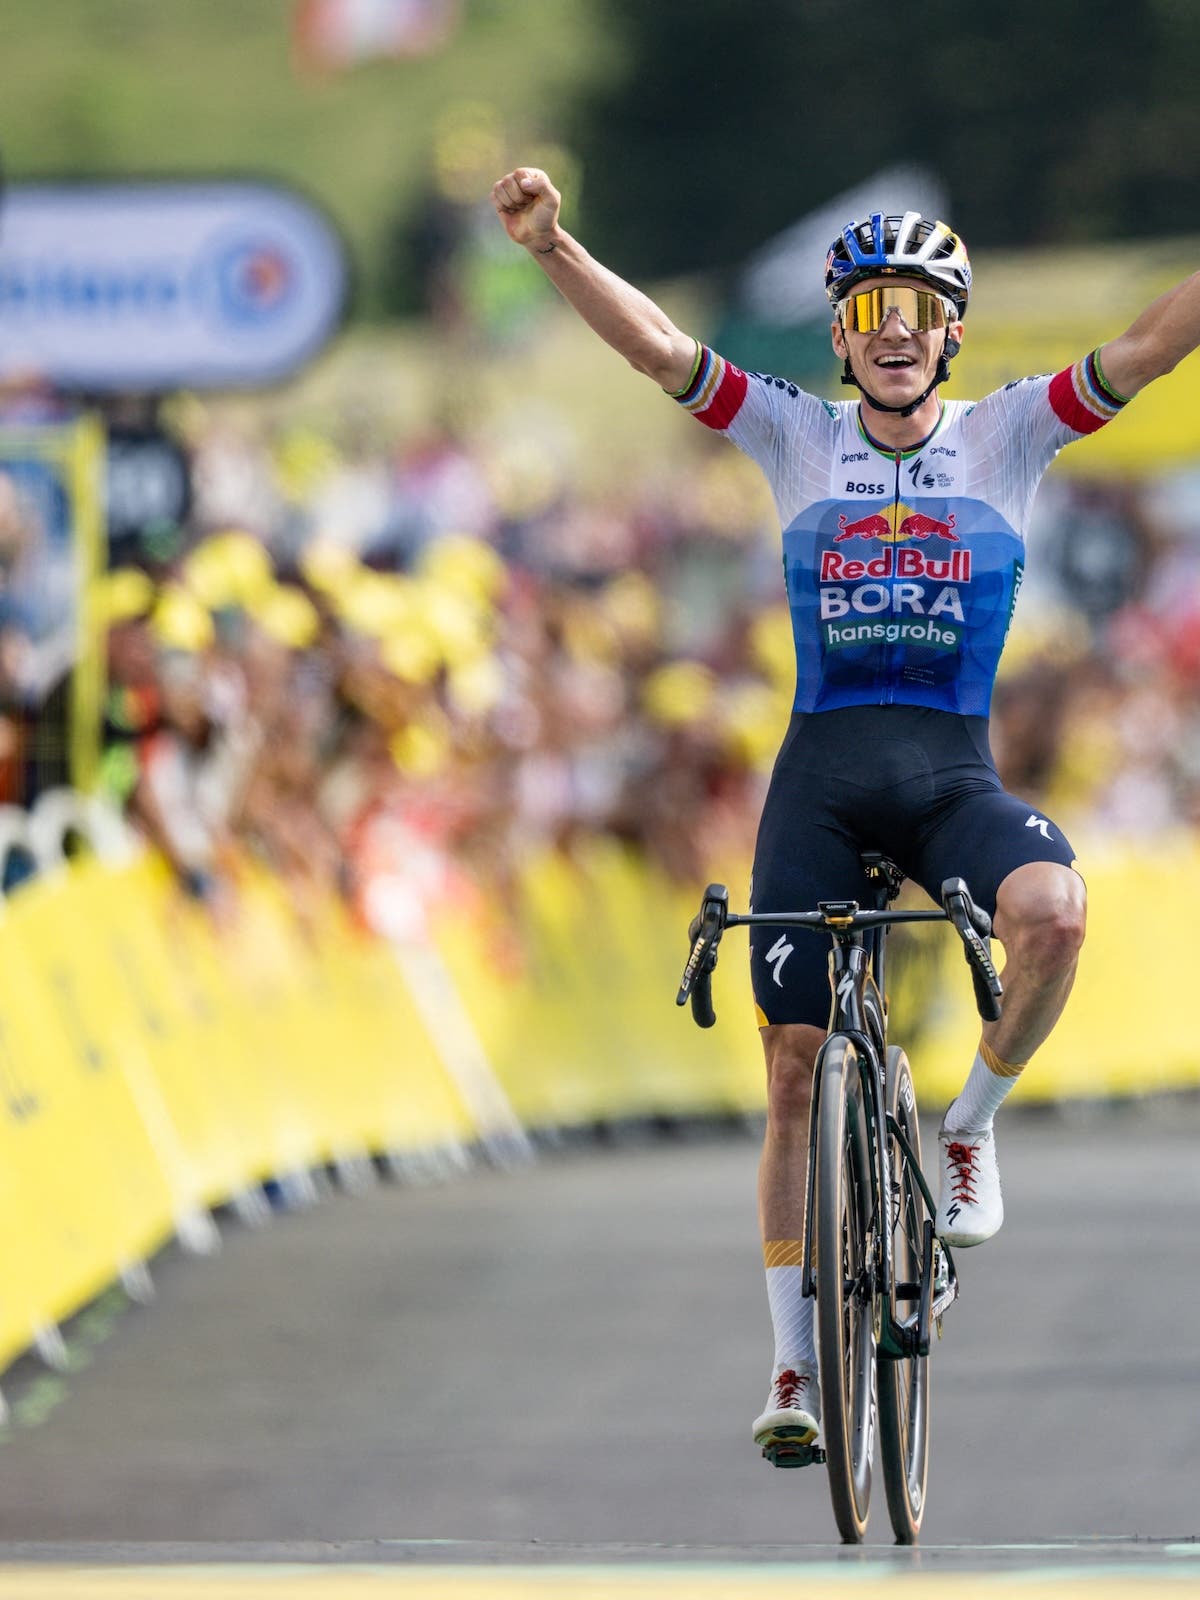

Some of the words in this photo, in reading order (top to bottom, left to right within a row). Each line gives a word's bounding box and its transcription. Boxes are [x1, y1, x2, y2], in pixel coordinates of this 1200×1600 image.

[841, 452, 869, 463] grenke
[930, 446, 957, 457] grenke
[846, 481, 885, 494] BOSS
[820, 547, 893, 583] Red
[896, 548, 972, 584] Bull
[819, 583, 965, 622] BORA
[827, 620, 957, 645] hansgrohe
